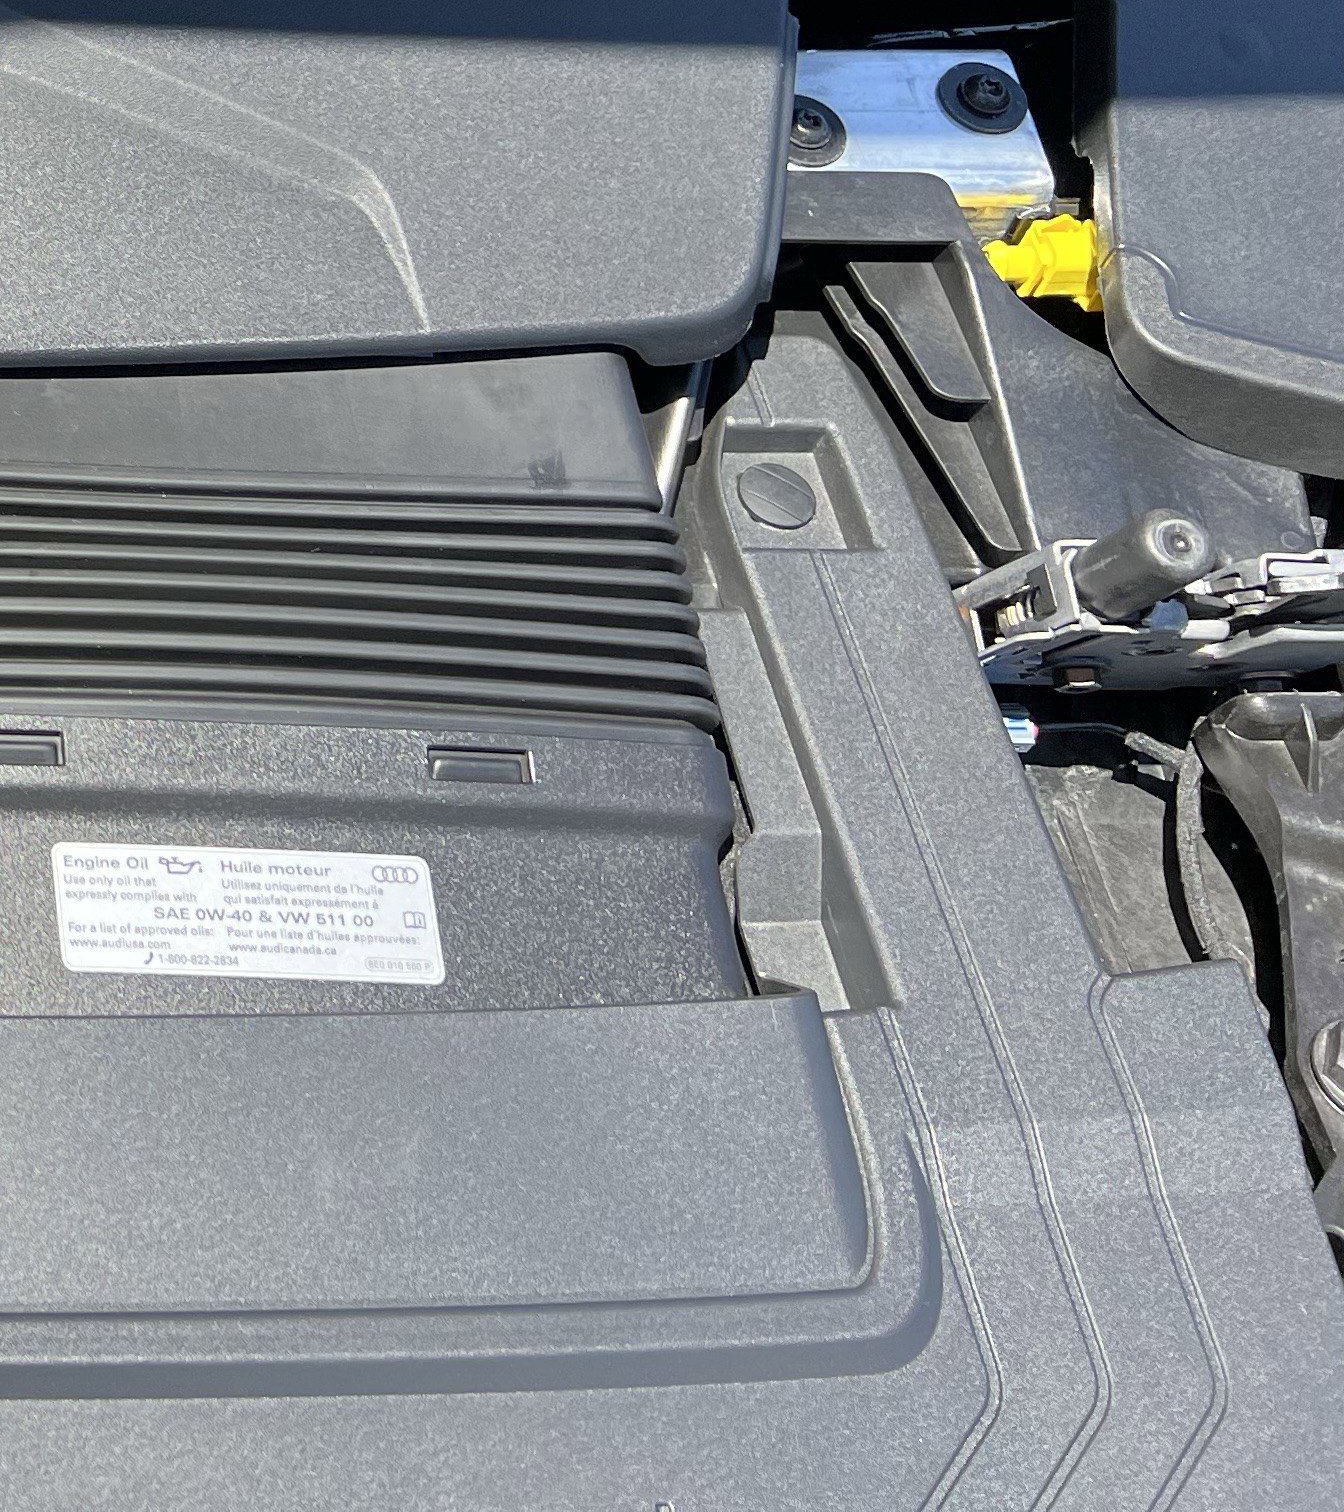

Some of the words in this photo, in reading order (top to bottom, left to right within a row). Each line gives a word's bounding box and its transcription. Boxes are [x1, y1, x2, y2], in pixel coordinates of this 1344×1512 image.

[63, 854, 120, 870] Engine
[126, 856, 149, 870] Oil
[220, 860, 262, 874] Huile
[268, 863, 332, 877] moteur
[63, 873, 86, 885] Use
[89, 875, 113, 887] only
[116, 875, 131, 886] oil
[133, 875, 157, 887] that
[221, 878, 262, 890] Utilisez
[265, 881, 332, 895] uniquement
[334, 883, 348, 895] de
[65, 889, 117, 903] expressly
[120, 890, 170, 903] complies
[173, 891, 198, 903] with
[223, 894, 242, 906] qui
[244, 894, 288, 907] satisfait
[153, 907, 191, 921] SAE
[195, 908, 253, 923] 0W-40
[258, 910, 272, 923] &
[278, 911, 310, 925] VW
[316, 912, 346, 926] 511
[353, 914, 374, 927] 00
[68, 921, 86, 933] For
[90, 924, 97, 933] a
[99, 921, 117, 934] list
[120, 922, 132, 934] of
[134, 924, 188, 937] approved
[226, 926, 254, 939] Pour
[256, 929, 277, 939] une
[280, 928, 304, 940] liste
[69, 938, 171, 950] www.audiusa.com
[229, 942, 337, 955] www.audicanada.ca
[158, 953, 239, 966] 1-800-822-2834
